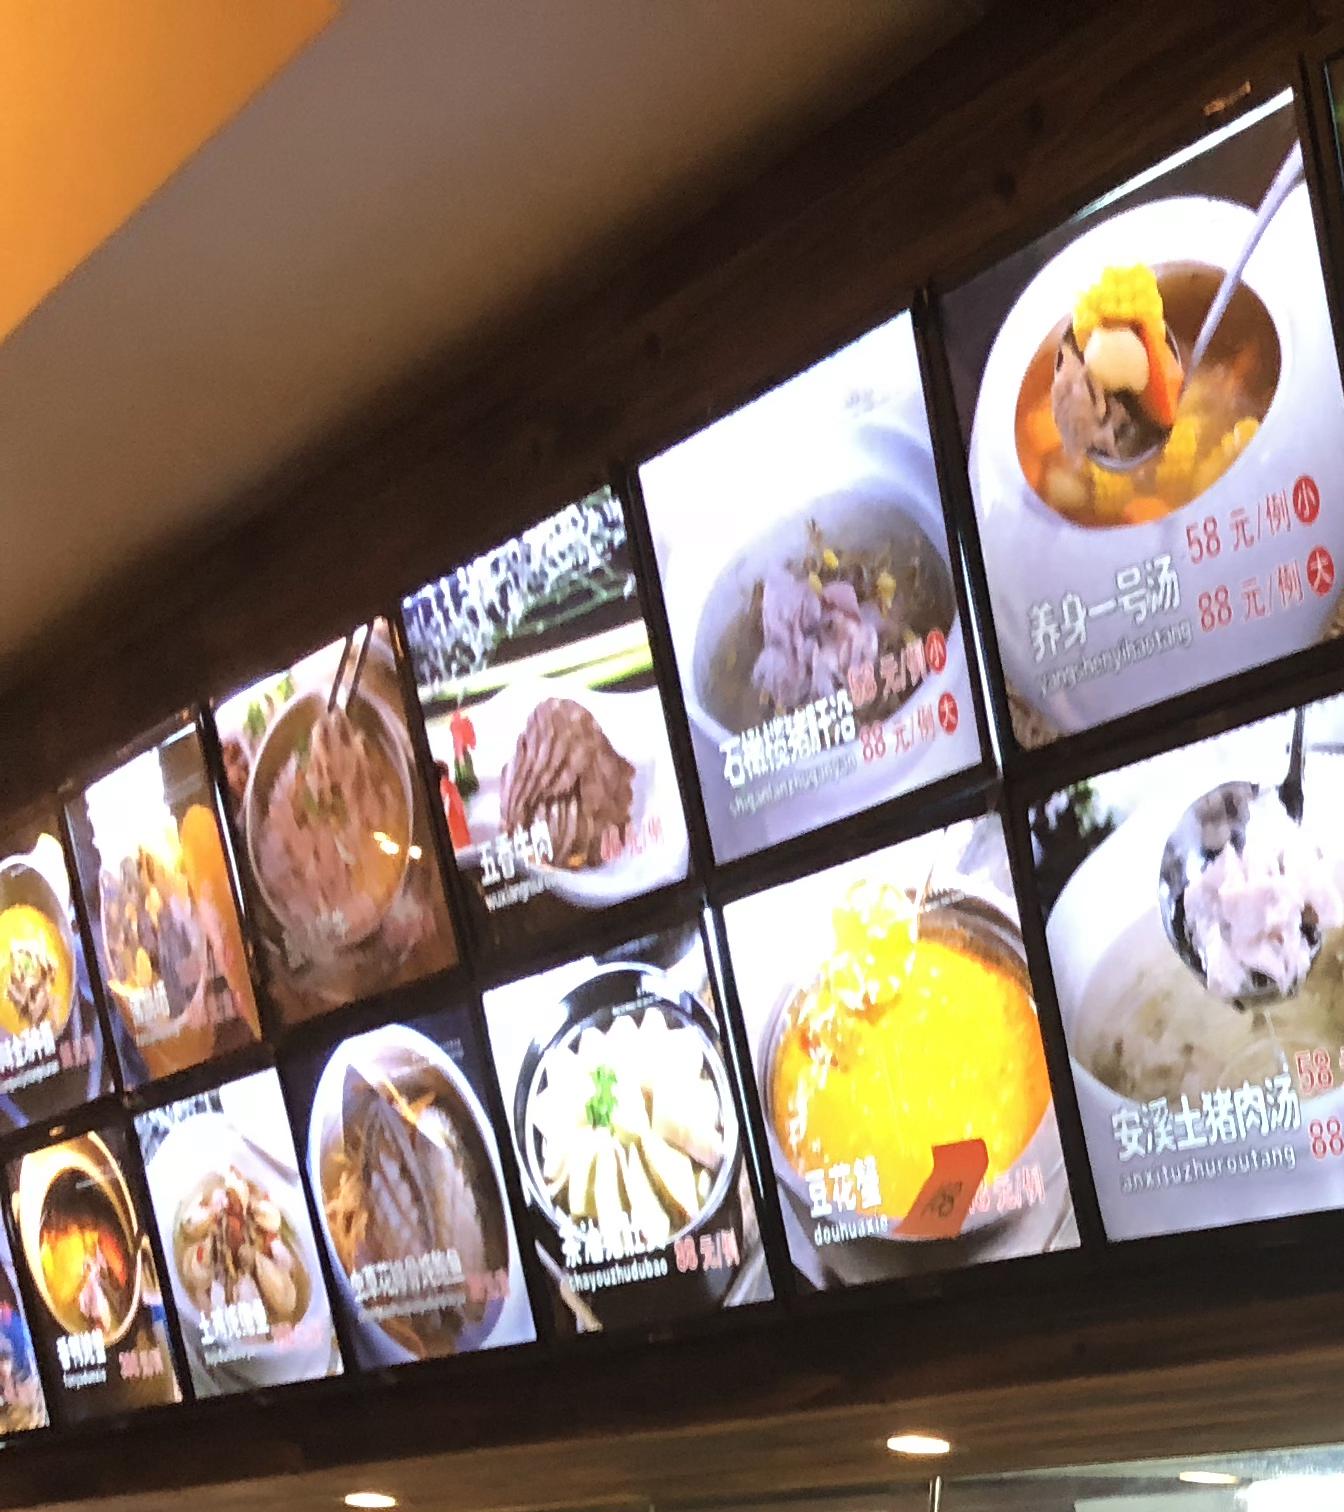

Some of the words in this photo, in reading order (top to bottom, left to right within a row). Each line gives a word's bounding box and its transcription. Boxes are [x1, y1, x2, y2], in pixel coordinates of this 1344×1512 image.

[1185, 516, 1221, 565] 58
[1229, 493, 1293, 554] 元/例
[1294, 477, 1318, 523] 小
[1027, 554, 1182, 664] 养身一号汤
[1199, 584, 1232, 633] 88
[1241, 560, 1304, 622] 元/例
[1308, 549, 1334, 594] 大
[926, 630, 947, 671] 小
[860, 719, 887, 765] 88
[937, 694, 958, 733] 大
[1295, 1048, 1334, 1096] 58
[1111, 1073, 1302, 1162] 安溪土猪肉汤
[1309, 1116, 1344, 1159] 88
[805, 1155, 882, 1218] 豆花蟹
[1120, 1144, 1297, 1193] anxituzhuroutang
[813, 1214, 889, 1247] douhuaxie
[567, 1257, 668, 1294] chayouzhudubao
